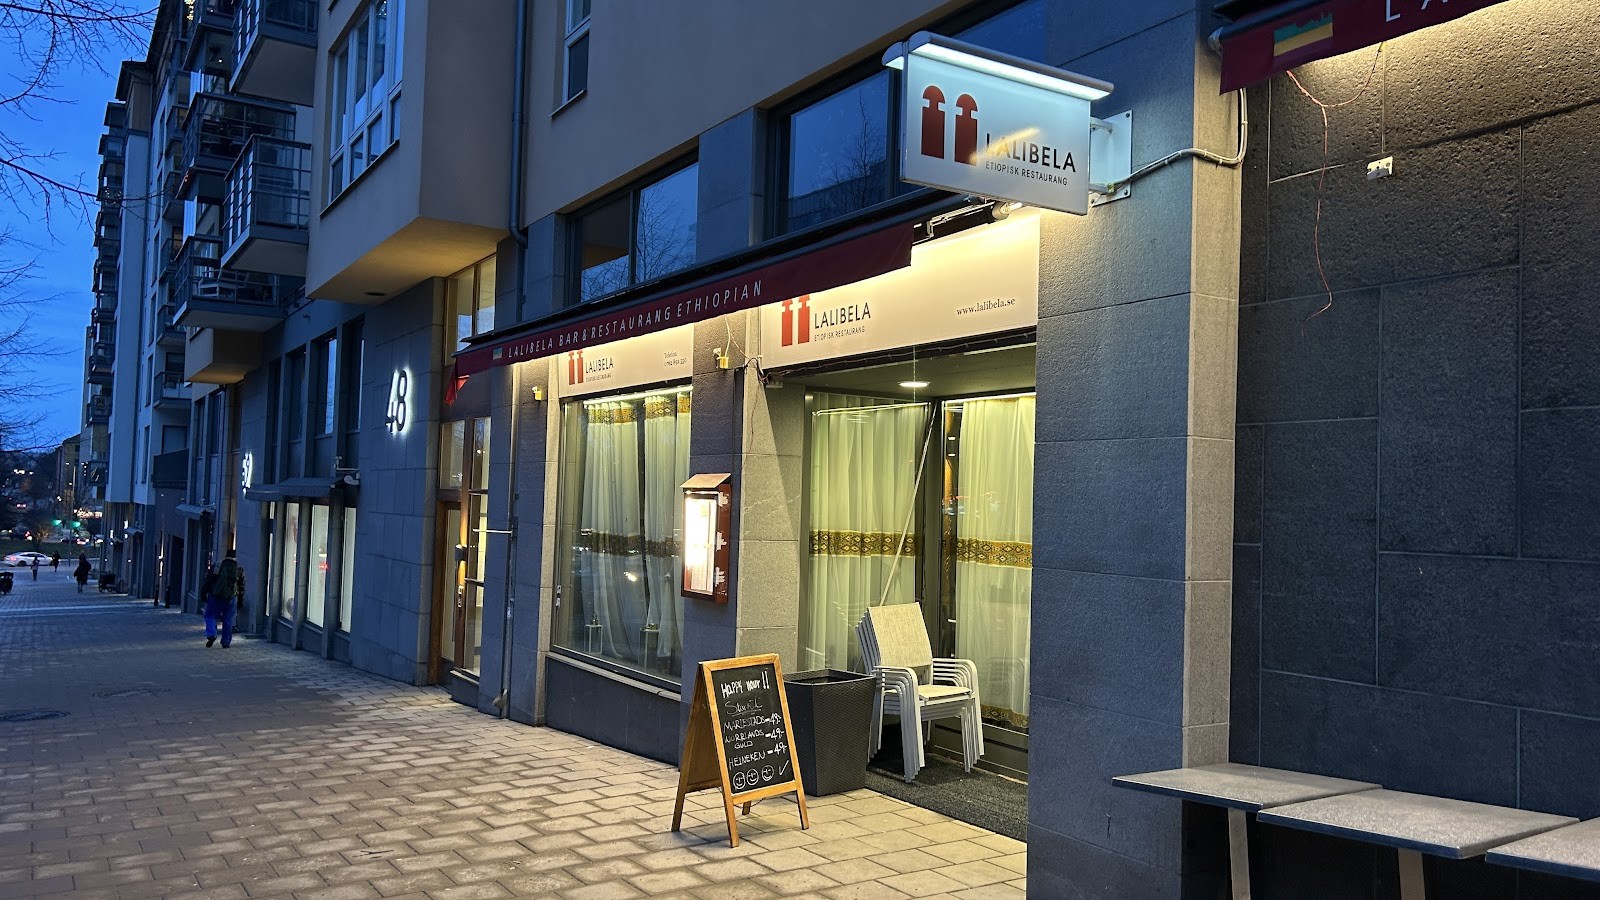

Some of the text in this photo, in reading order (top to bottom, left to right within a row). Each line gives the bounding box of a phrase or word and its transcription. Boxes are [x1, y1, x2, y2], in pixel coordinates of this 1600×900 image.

[986, 132, 1076, 173] LALIBELA
[985, 160, 1068, 186] ETIOPISK RESTAURANG
[508, 337, 553, 358] LALIBELA
[559, 331, 579, 347] BAR
[590, 306, 671, 339] RESTAURANG
[676, 280, 762, 317] ETHIOPIAN
[814, 302, 871, 329] LALIBELA
[956, 298, 1016, 315] www.lalibela.se
[585, 356, 614, 374] LALIBELA
[386, 369, 409, 434] 48
